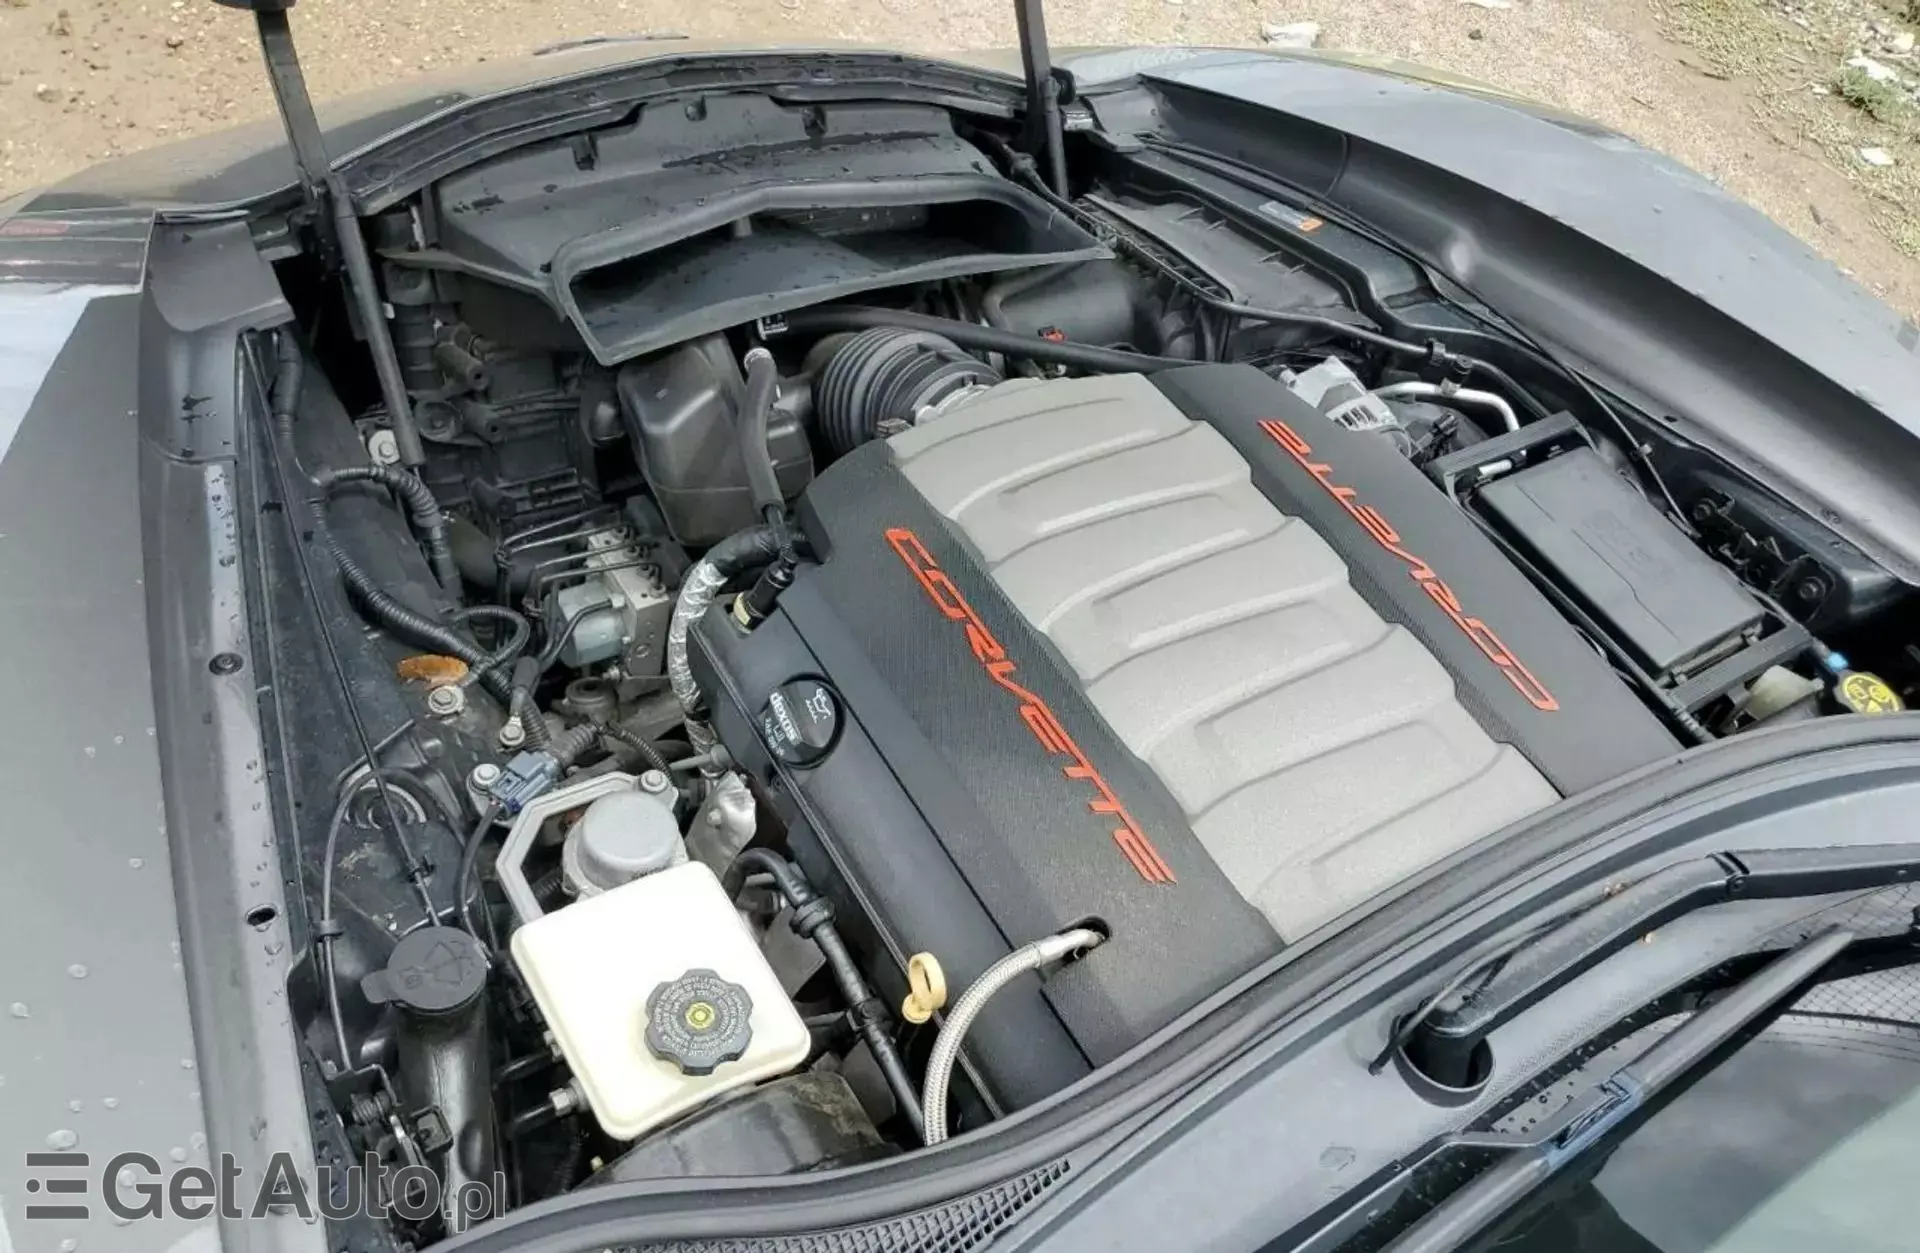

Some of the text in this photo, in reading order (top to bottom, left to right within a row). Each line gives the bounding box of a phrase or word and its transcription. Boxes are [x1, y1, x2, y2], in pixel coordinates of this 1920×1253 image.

[884, 527, 1177, 884] CORVETTE
[1257, 420, 1560, 712] CORVETTE
[769, 691, 799, 745] dexos
